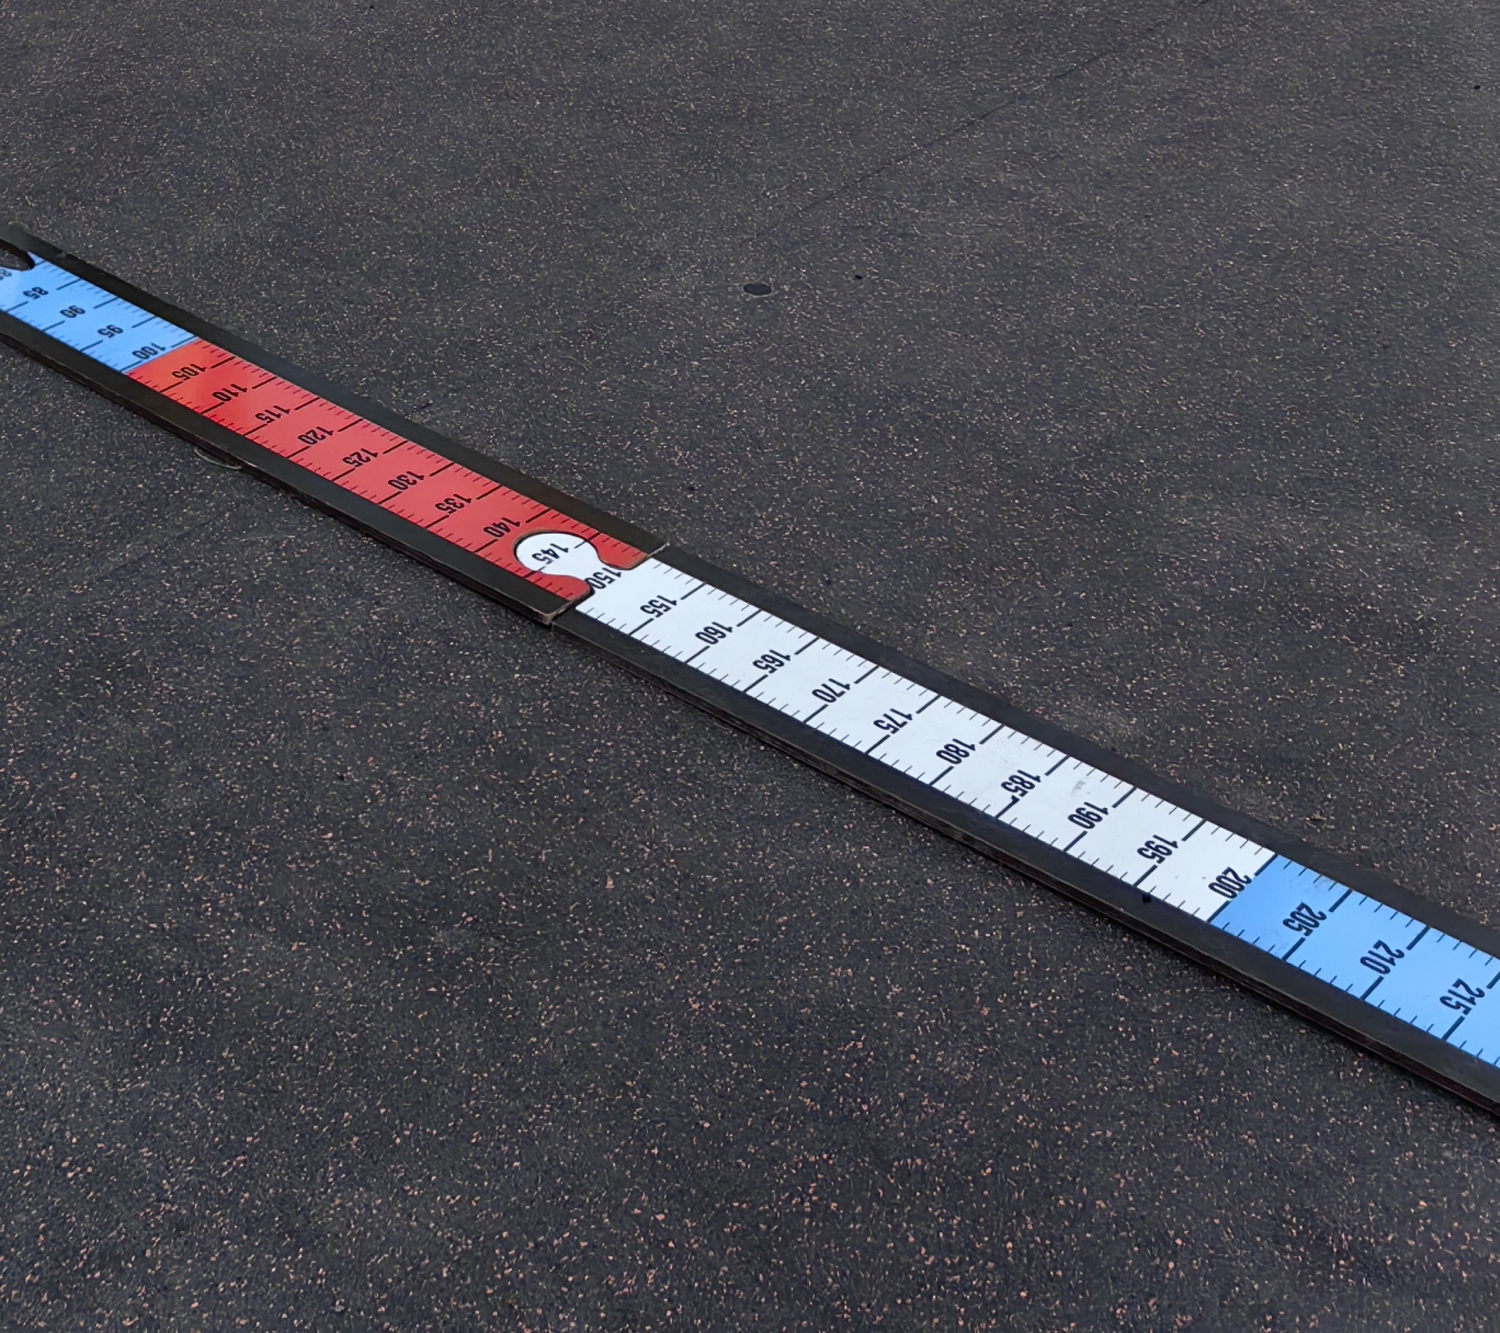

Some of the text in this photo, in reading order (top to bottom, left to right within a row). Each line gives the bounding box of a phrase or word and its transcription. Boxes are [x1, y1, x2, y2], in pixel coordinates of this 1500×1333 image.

[23, 286, 49, 299] 85
[59, 304, 86, 318] 90
[97, 324, 124, 338] 95
[132, 341, 166, 360] 100
[171, 363, 207, 381] 105
[212, 383, 248, 402] 110
[254, 405, 291, 424] 115
[298, 425, 334, 446] 120
[342, 447, 379, 468] 125
[388, 470, 425, 491] 130
[435, 493, 472, 515] 135
[483, 516, 521, 538] 140
[532, 543, 570, 565] 145
[587, 566, 623, 590] 150
[639, 595, 678, 619] 155
[694, 621, 734, 646] 160
[752, 649, 792, 675] 165
[811, 678, 851, 704] 170
[873, 708, 913, 734] 175
[935, 738, 976, 765] 180
[1000, 769, 1042, 798] 185
[1067, 801, 1109, 830] 190
[1136, 834, 1179, 864] 195
[1208, 866, 1252, 900] 200
[1282, 902, 1327, 937] 205
[1359, 939, 1405, 975] 210
[1439, 978, 1486, 1016] 215
